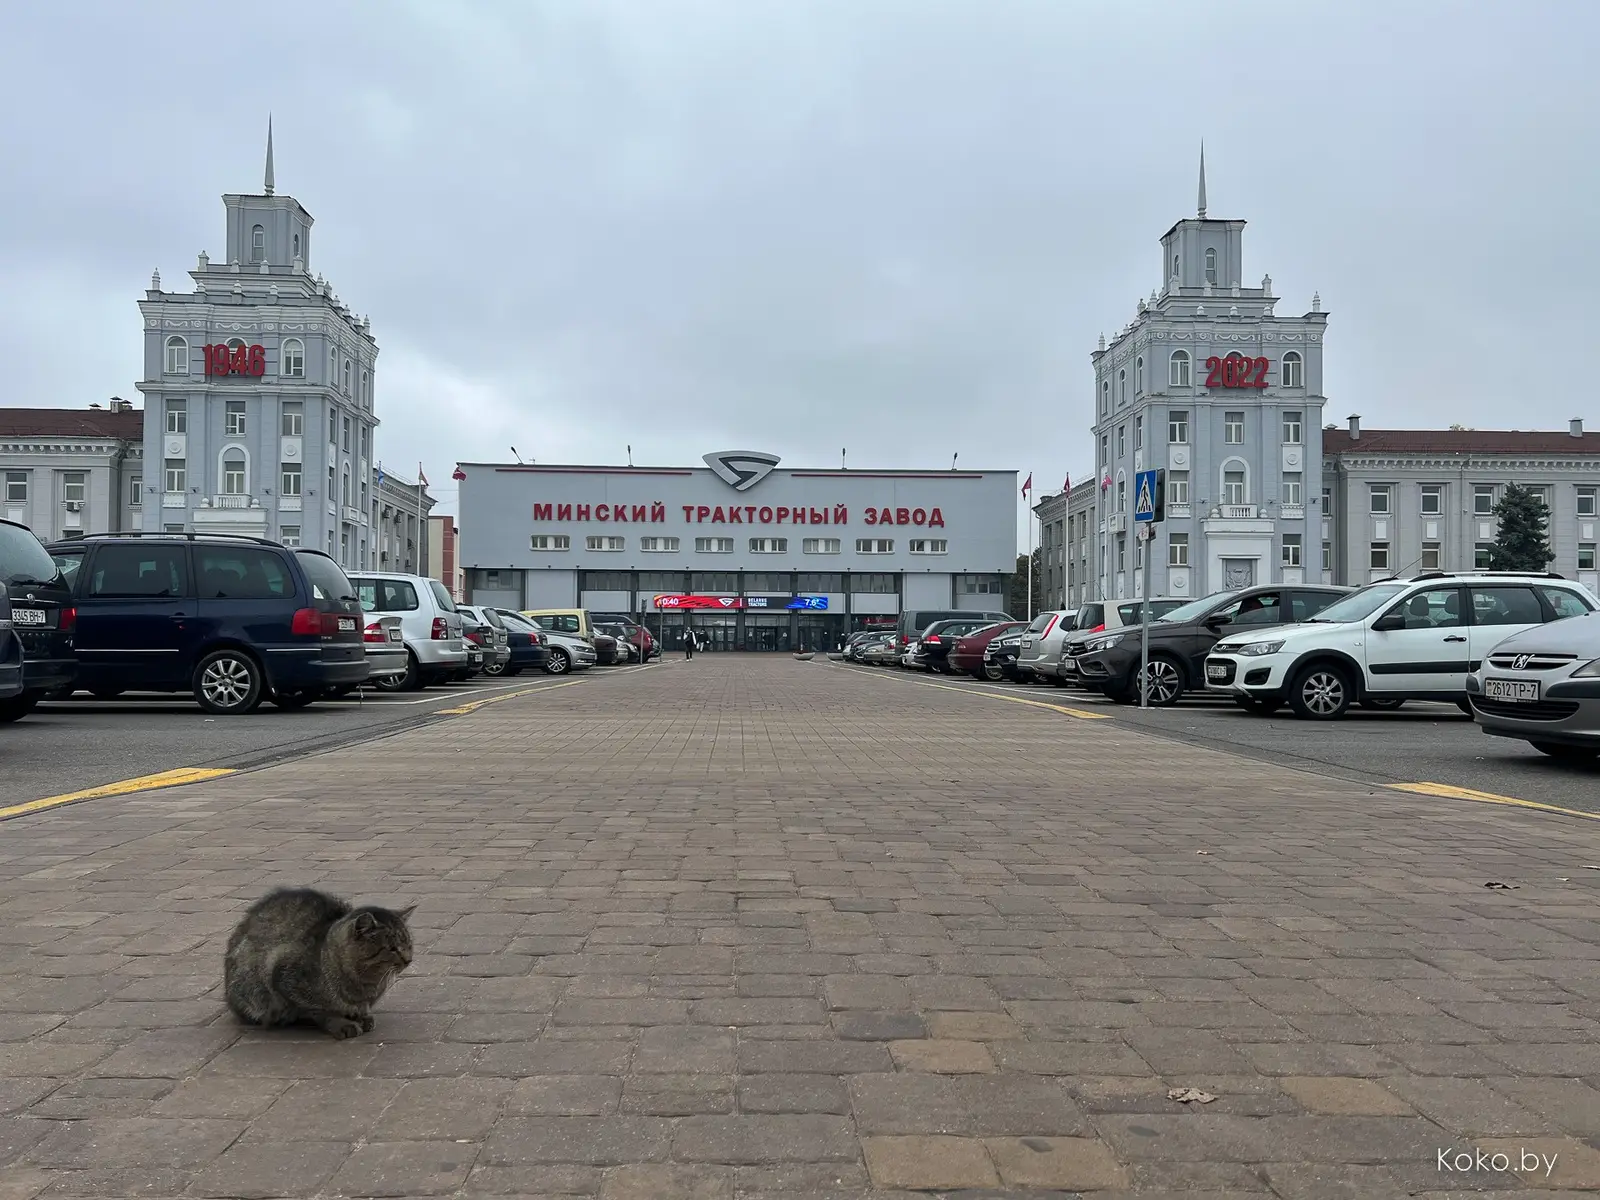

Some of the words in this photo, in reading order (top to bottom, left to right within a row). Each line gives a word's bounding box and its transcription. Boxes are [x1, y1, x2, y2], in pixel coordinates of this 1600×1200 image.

[202, 344, 265, 376] 1946
[1206, 356, 1269, 388] 2022
[533, 501, 665, 522] МИНСКИЙ
[682, 503, 848, 524] ТРАКТОРНЫЙ
[864, 507, 944, 528] ЗАВОД
